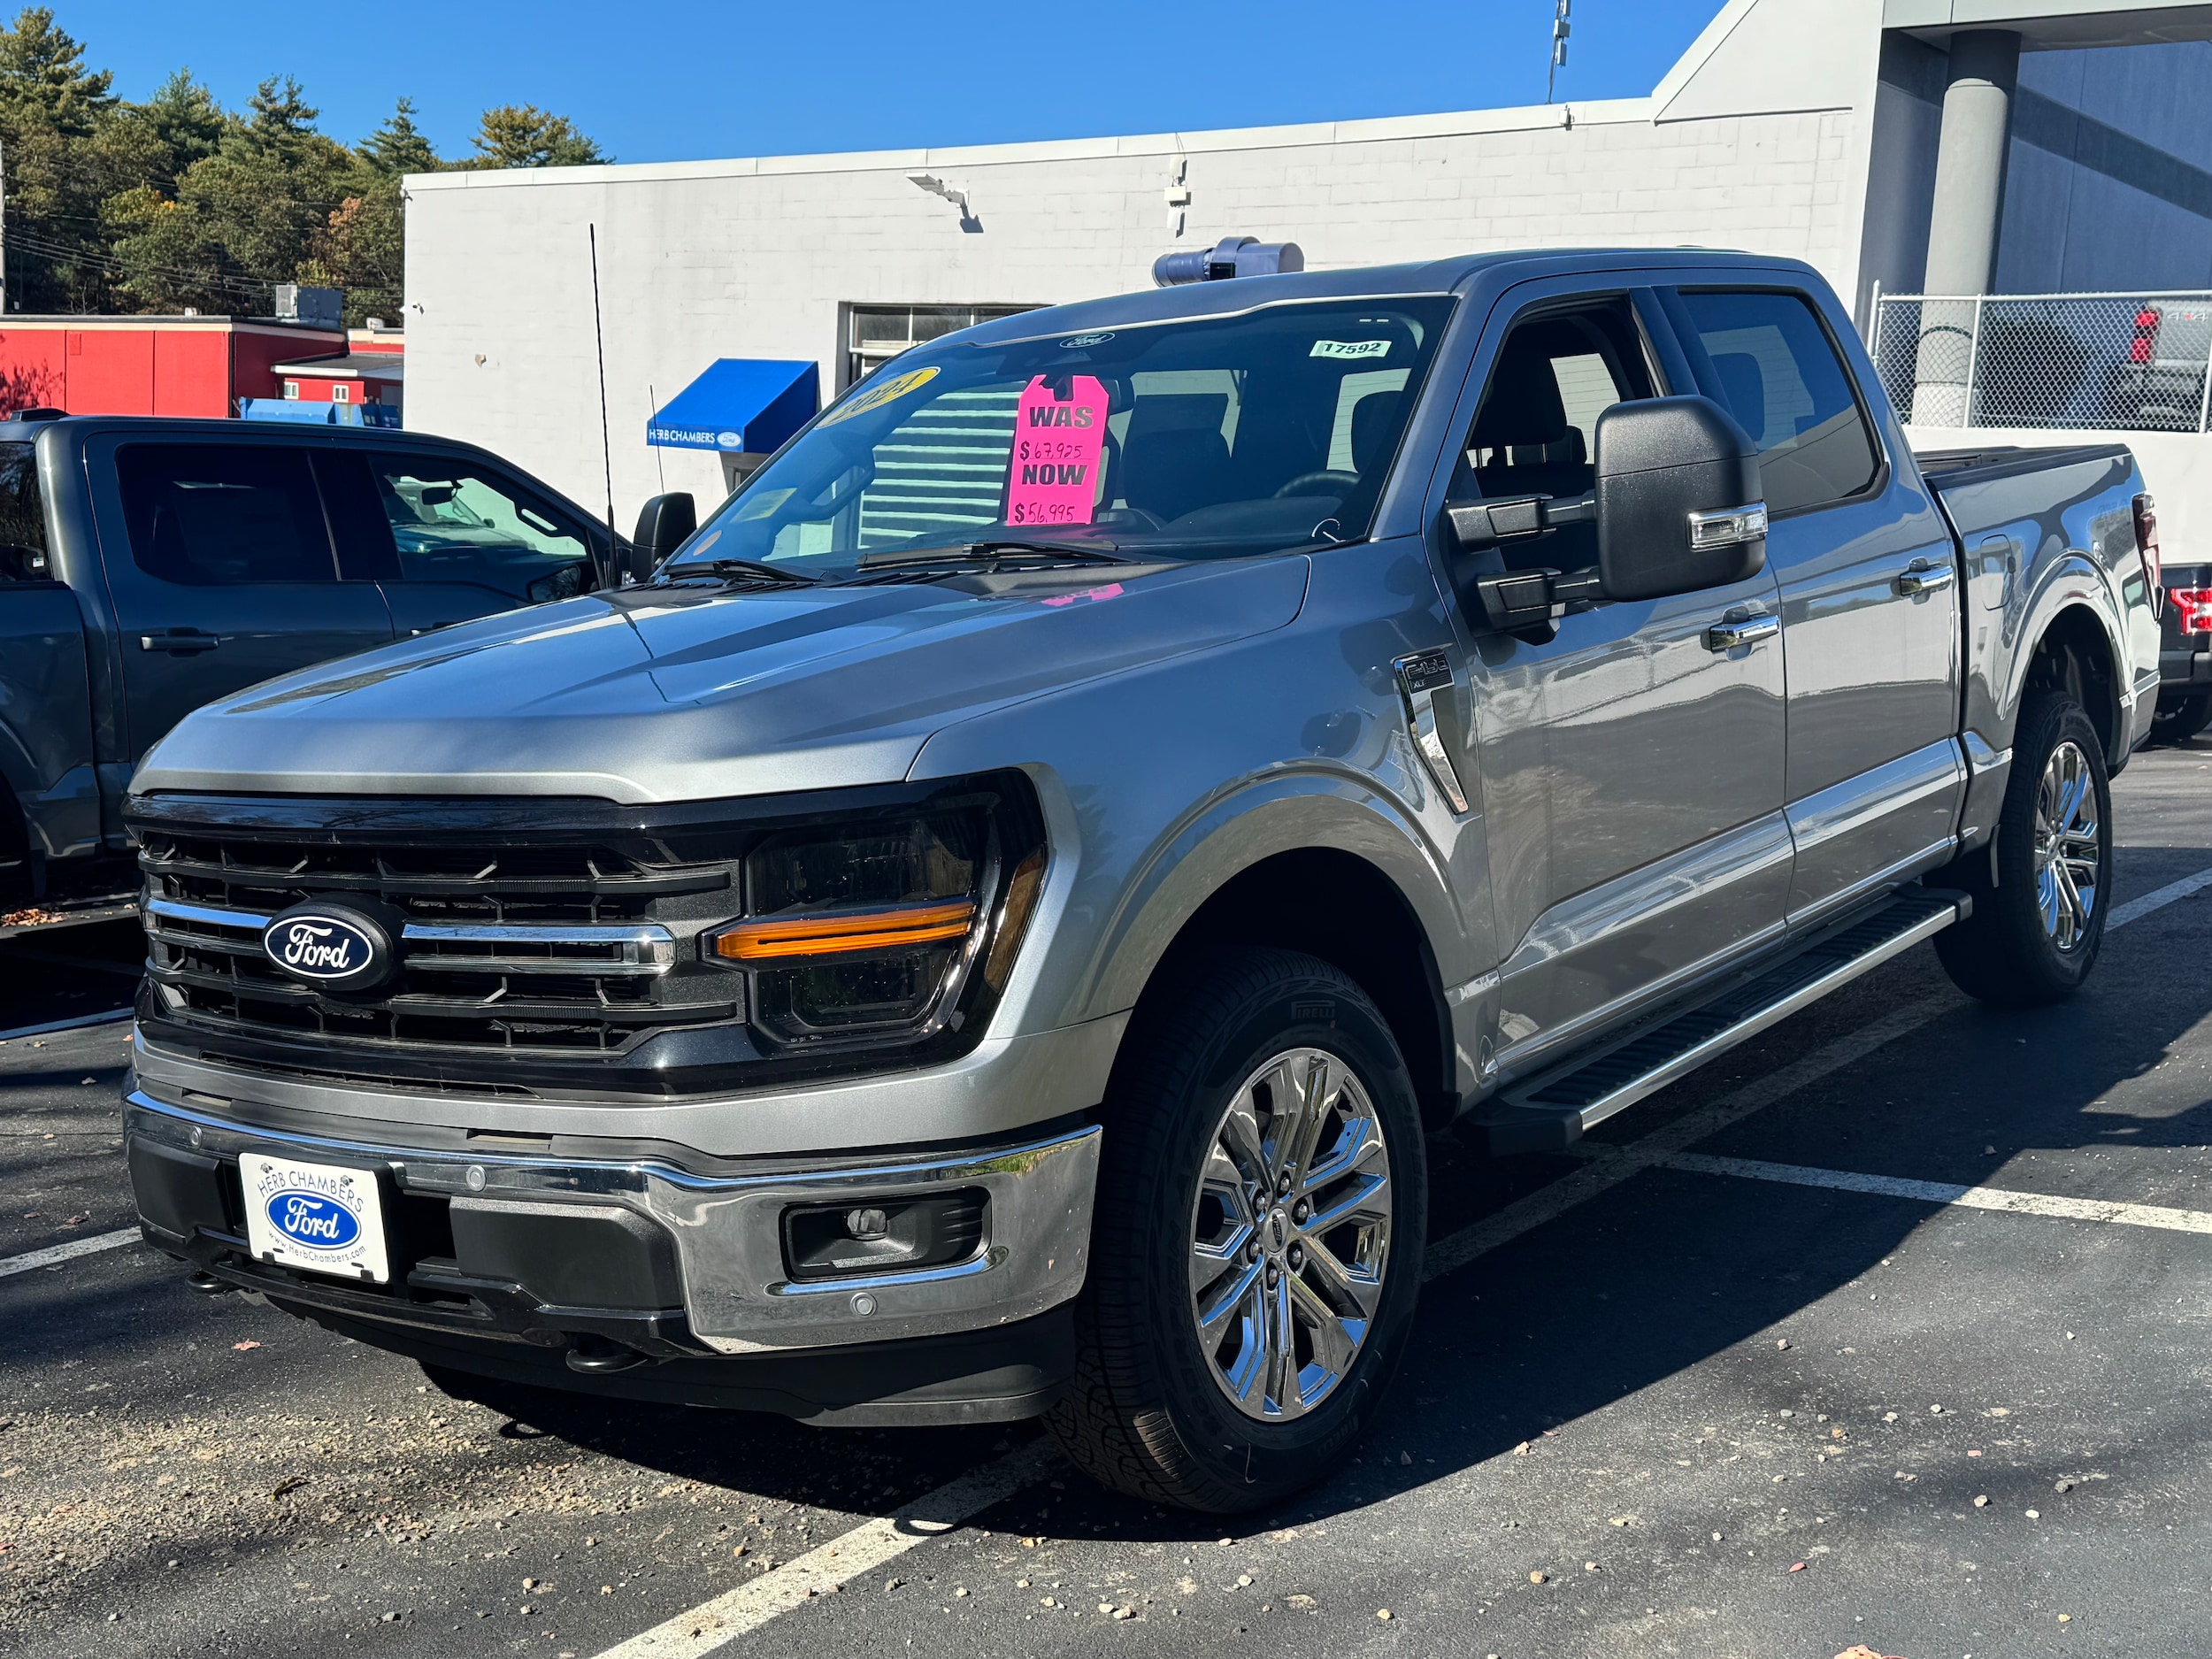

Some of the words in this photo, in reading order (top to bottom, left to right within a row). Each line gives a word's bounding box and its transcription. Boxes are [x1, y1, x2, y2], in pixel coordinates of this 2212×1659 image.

[1066, 334, 1108, 346] Ford
[1325, 342, 1381, 355] 17592
[828, 372, 924, 424] 2024
[1029, 406, 1094, 429] WAS
[649, 428, 670, 441] HERB
[670, 430, 716, 444] CHAMBERS
[1022, 464, 1087, 486] NOW
[1413, 679, 1425, 689] XLT
[285, 924, 350, 969] Ford
[1291, 1000, 1336, 1020] PIRELLI
[257, 1171, 286, 1198] HERB
[288, 1171, 365, 1213] CHAMBERS
[284, 1196, 340, 1240] Ford
[267, 1230, 366, 1263] www.HerbChambers.com
